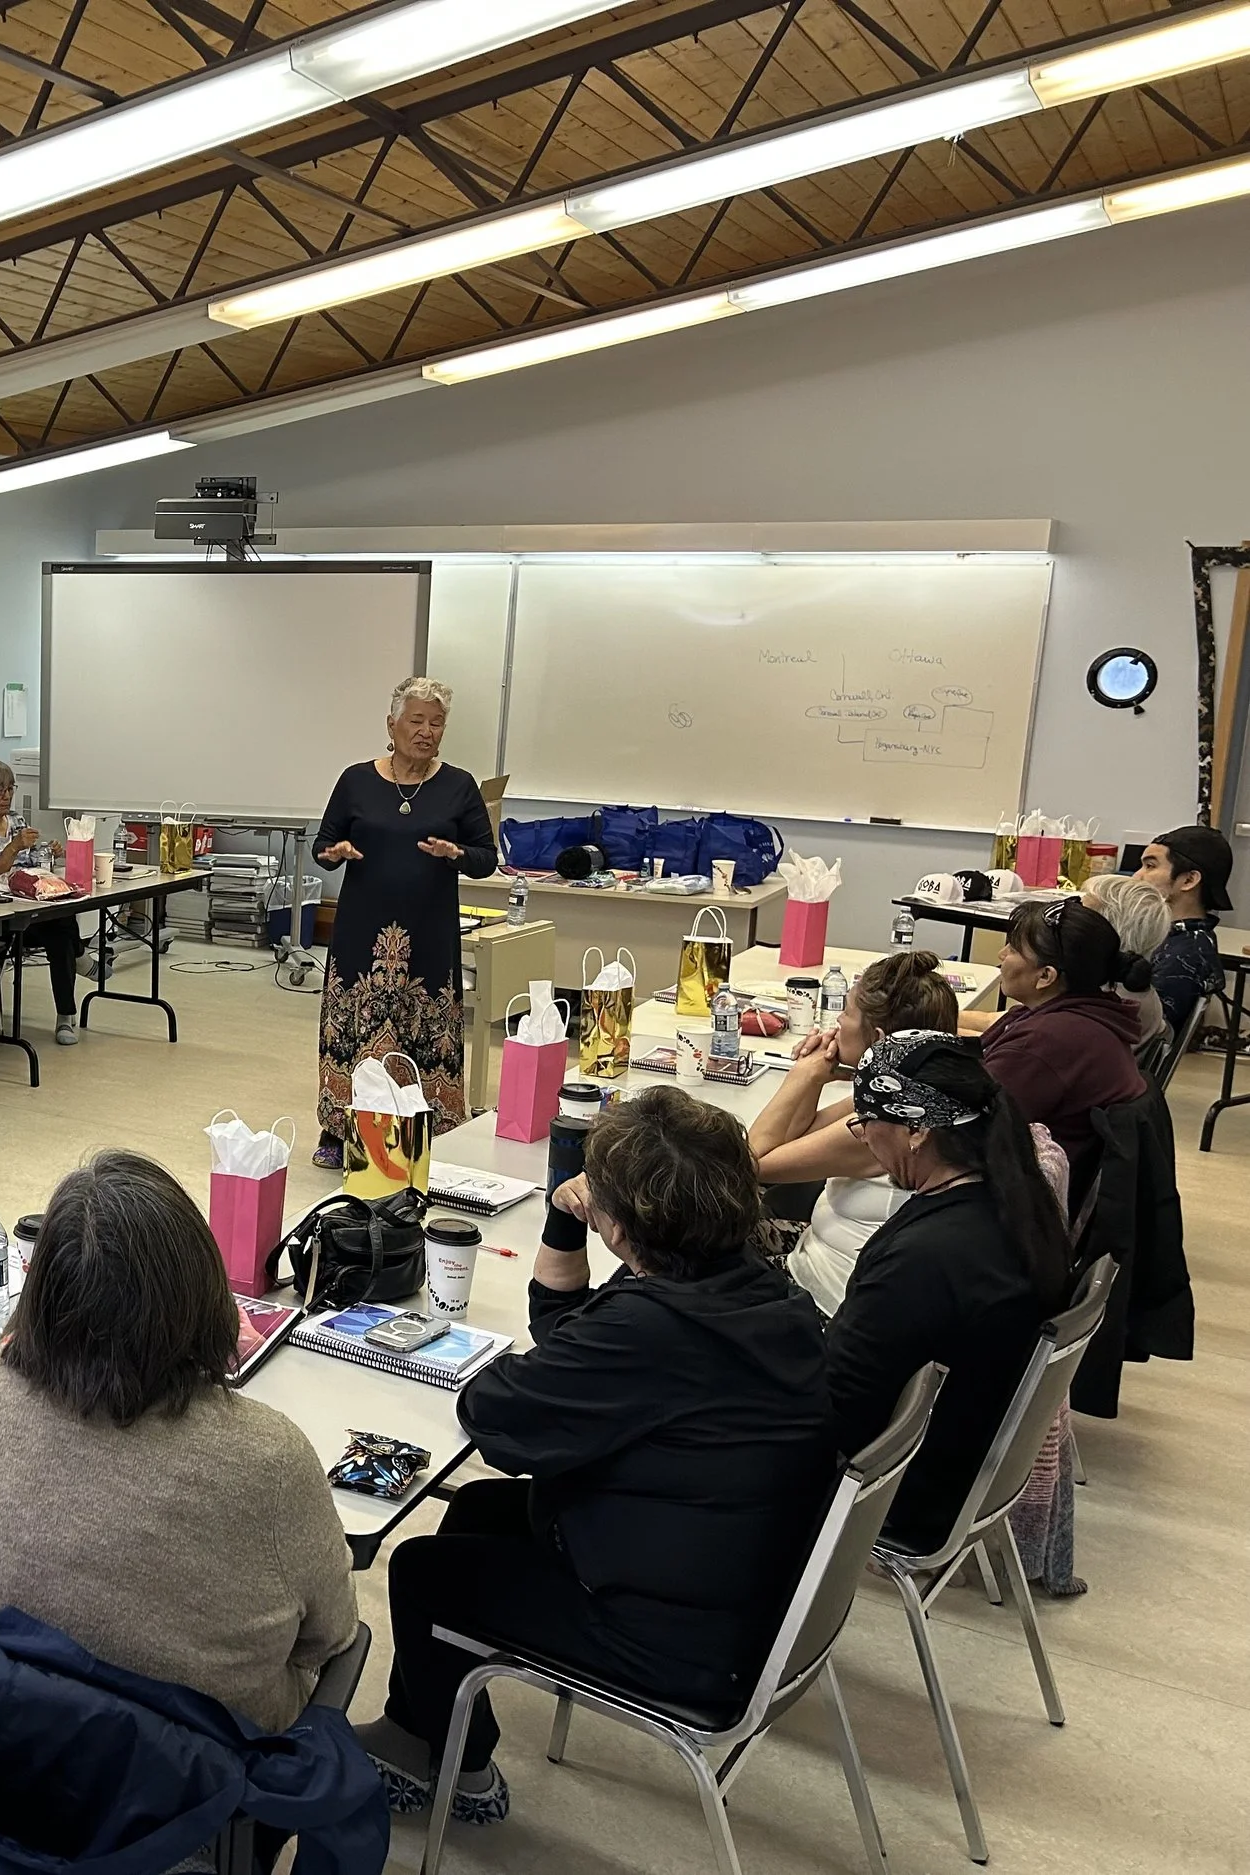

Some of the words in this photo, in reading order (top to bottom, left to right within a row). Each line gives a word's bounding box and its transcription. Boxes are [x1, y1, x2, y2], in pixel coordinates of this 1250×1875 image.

[759, 649, 817, 663] Montreal
[888, 648, 946, 669] Ottawa
[439, 1257, 456, 1265] Enjoy
